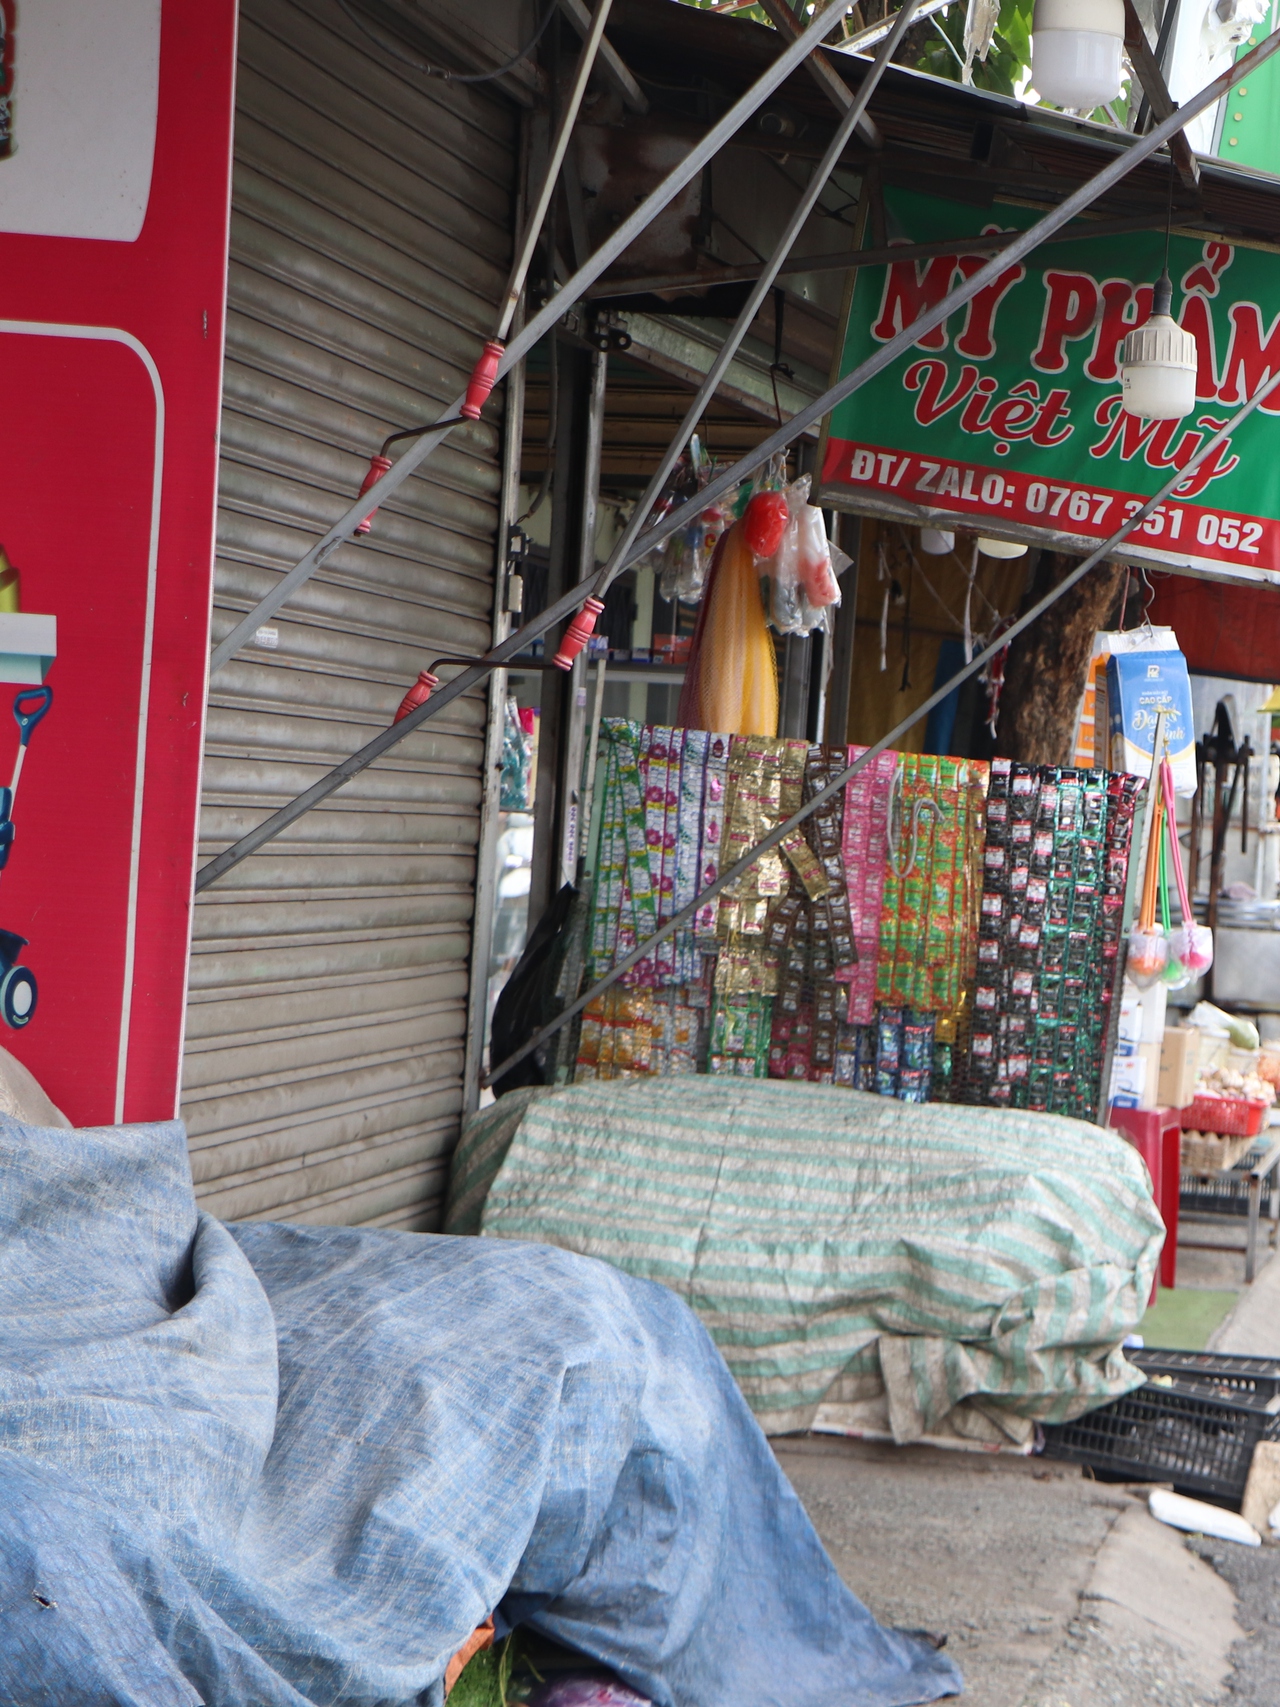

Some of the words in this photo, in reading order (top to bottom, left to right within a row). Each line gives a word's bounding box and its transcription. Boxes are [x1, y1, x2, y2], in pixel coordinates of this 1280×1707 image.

[902, 358, 1075, 457] Việt
[1089, 397, 1241, 499] Mỹ
[850, 448, 909, 488] ĐT/
[915, 461, 1015, 510] ZALO:
[1024, 481, 1115, 526] 0767
[1121, 496, 1184, 541] 351
[1196, 513, 1264, 556] 052
